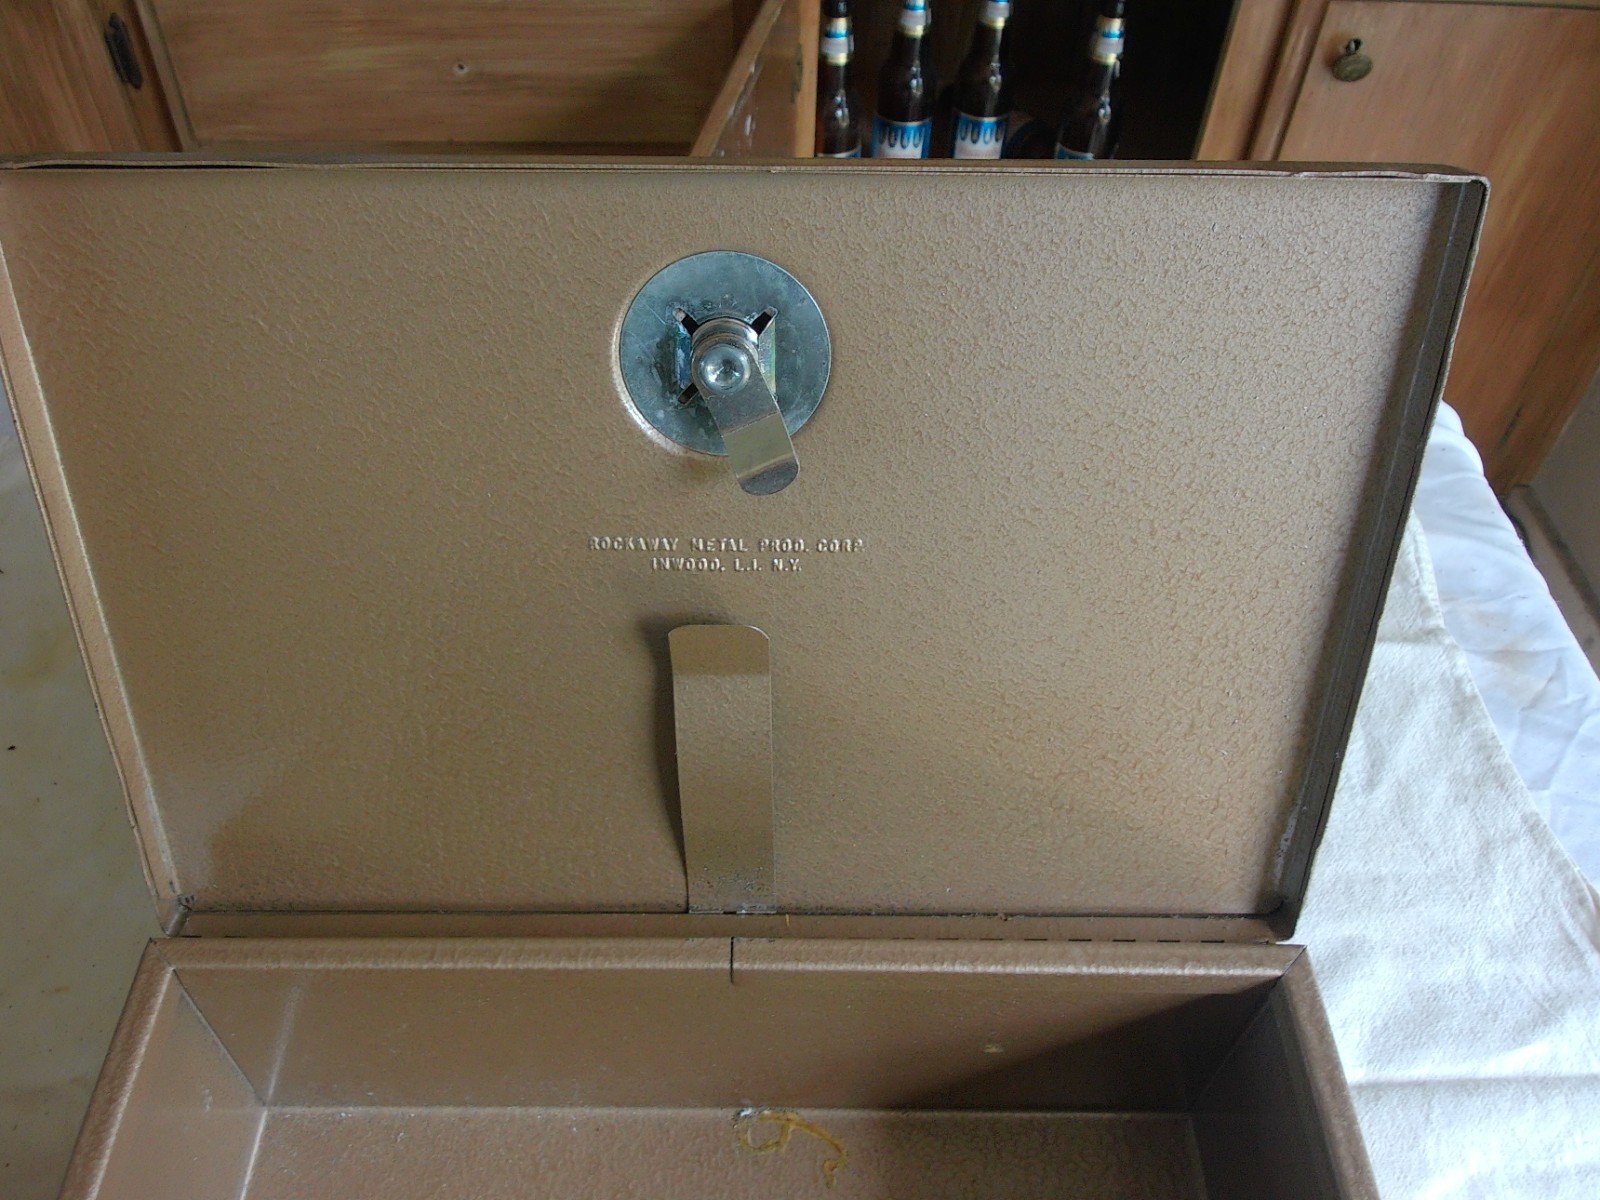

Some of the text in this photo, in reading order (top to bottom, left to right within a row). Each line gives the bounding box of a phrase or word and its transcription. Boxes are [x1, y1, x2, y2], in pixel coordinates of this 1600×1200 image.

[588, 536, 679, 551] ROCKAWAY
[690, 537, 748, 552] METAL
[758, 538, 810, 552] PROD.
